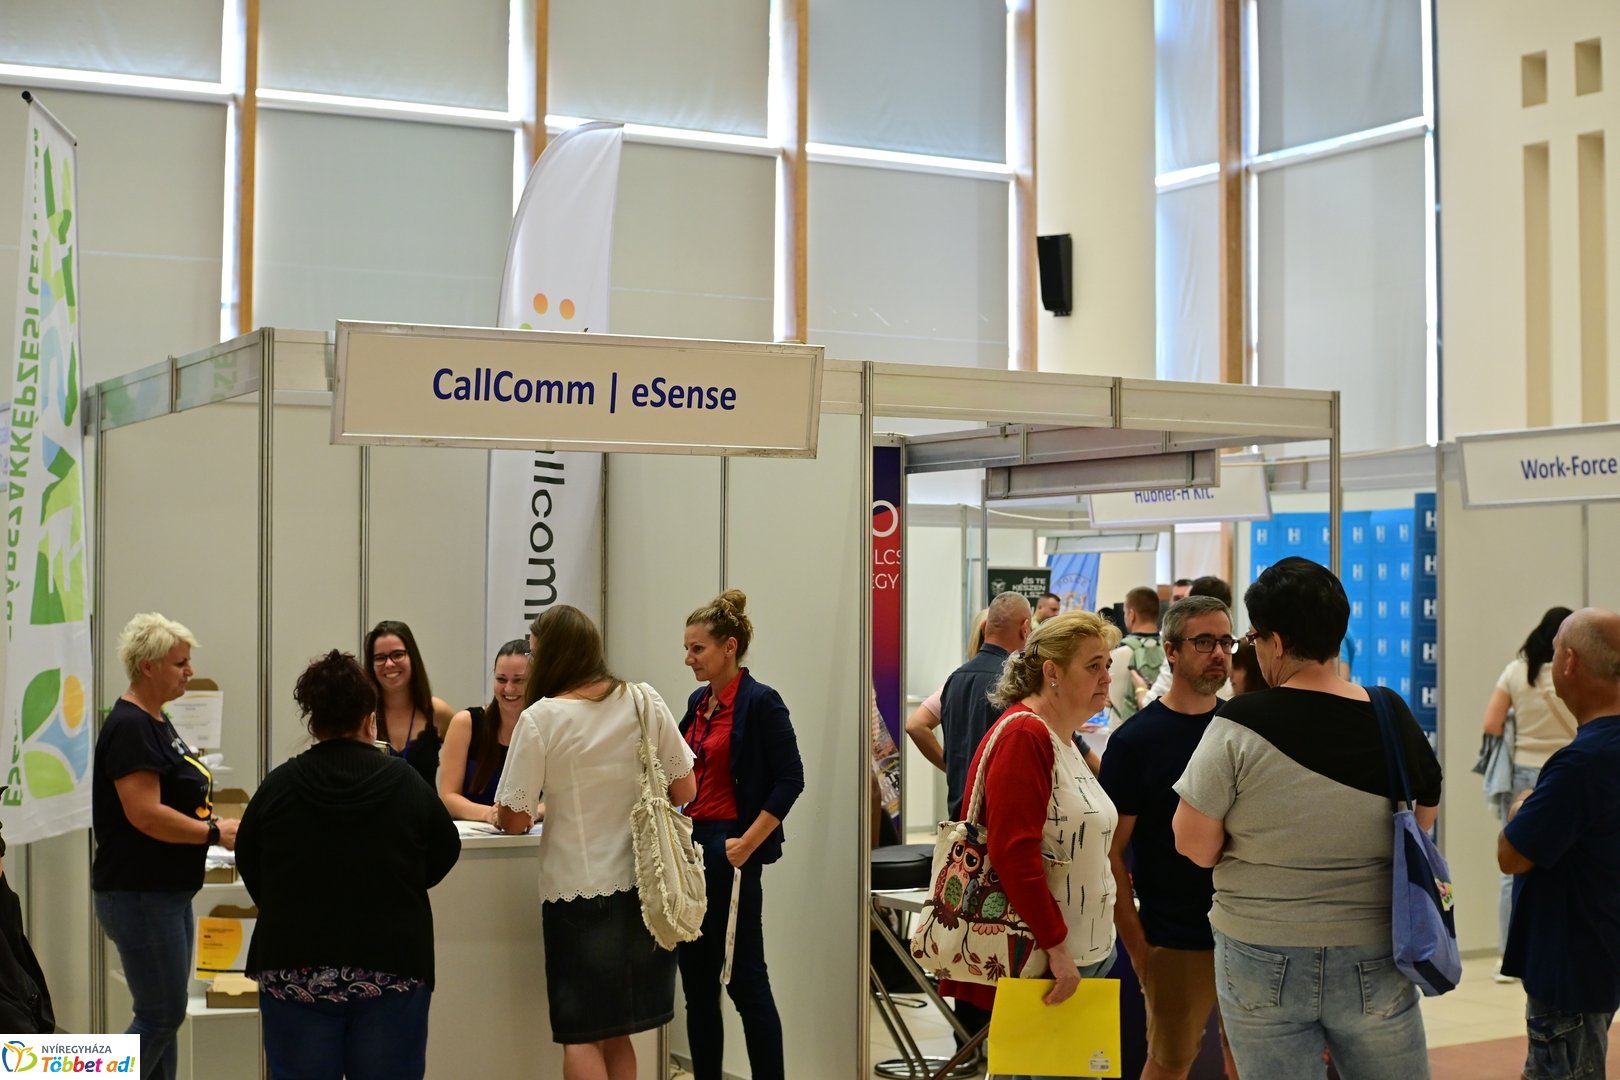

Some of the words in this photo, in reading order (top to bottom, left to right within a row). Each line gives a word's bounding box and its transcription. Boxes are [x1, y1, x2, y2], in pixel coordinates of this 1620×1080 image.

[432, 368, 595, 405] CallComm
[631, 376, 737, 410] eSense
[1520, 455, 1617, 479] Work-Force
[524, 450, 565, 642] llcom
[873, 573, 899, 589] GY
